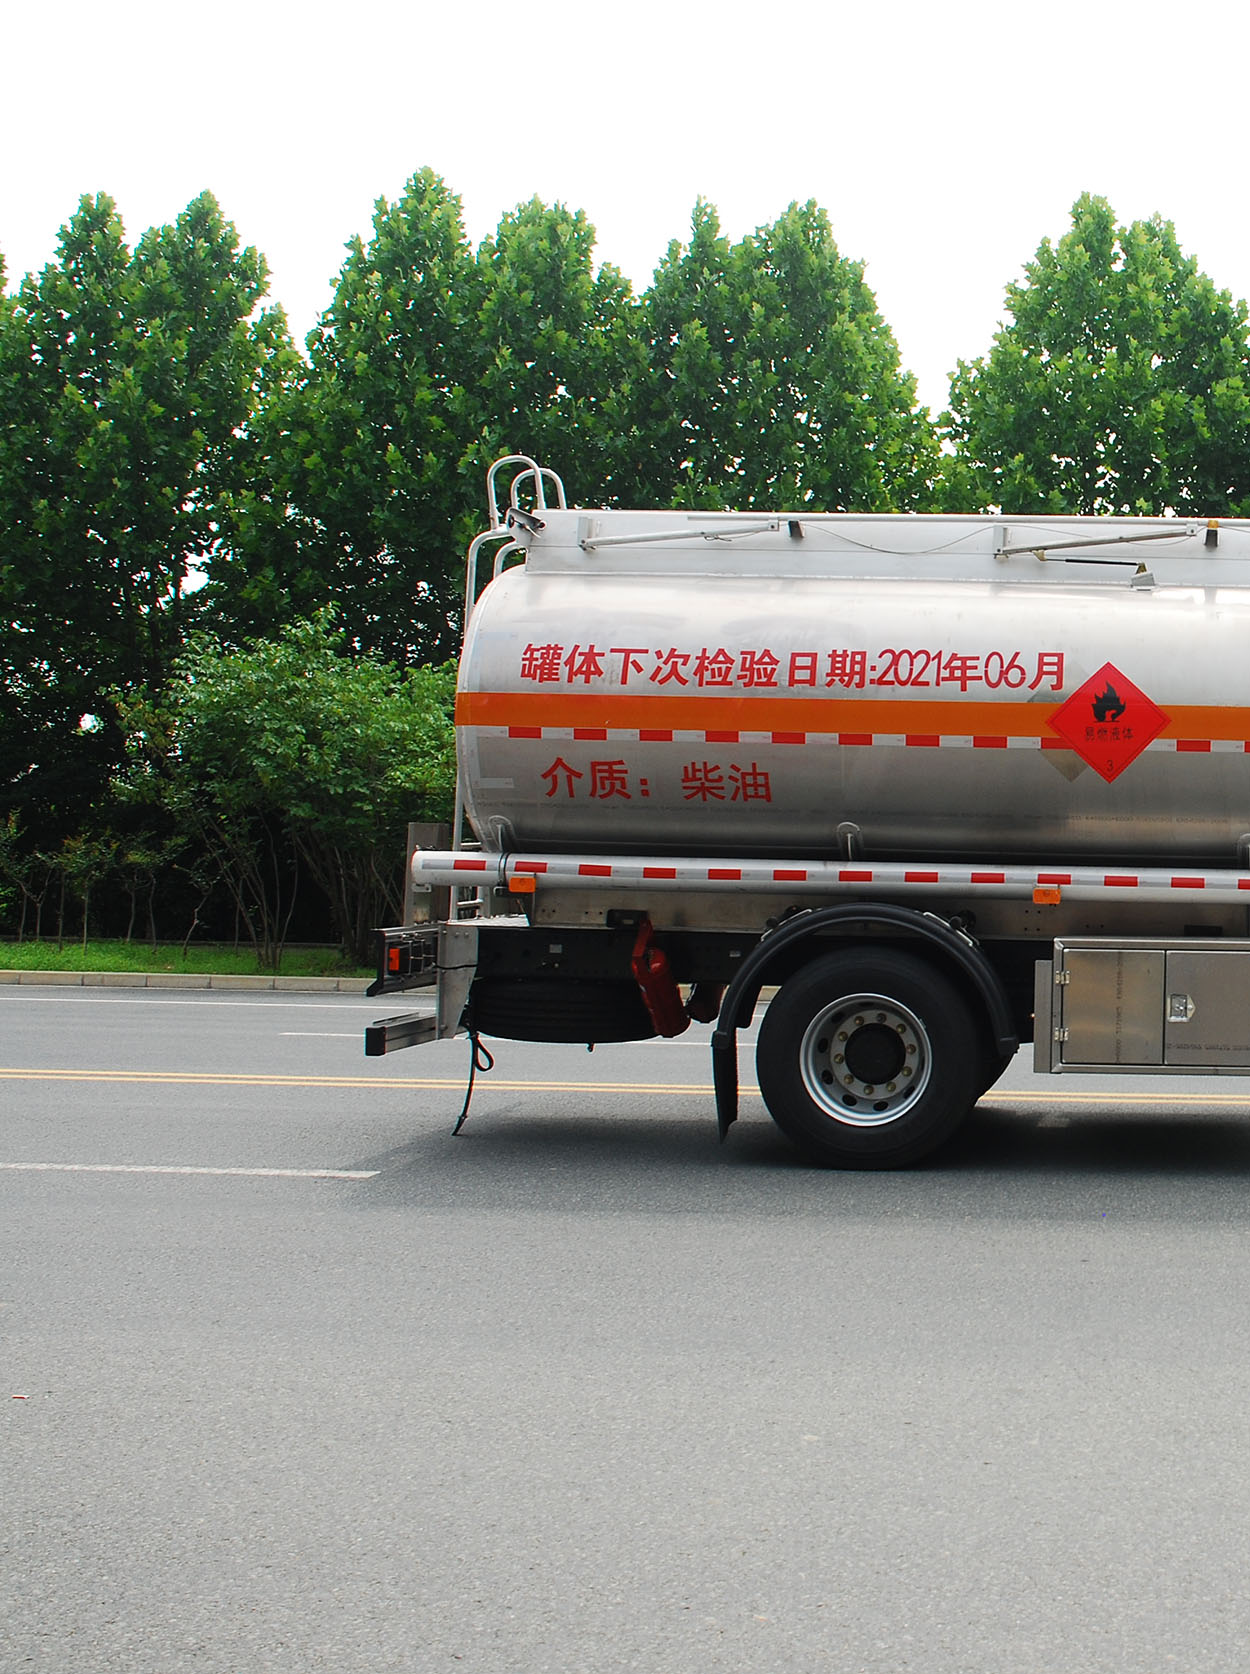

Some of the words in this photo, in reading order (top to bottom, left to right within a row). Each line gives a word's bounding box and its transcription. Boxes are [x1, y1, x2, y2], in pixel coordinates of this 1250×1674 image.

[520, 643, 1065, 692] 罐体下次检验日期:2021年06月
[1106, 760, 1114, 772] 3
